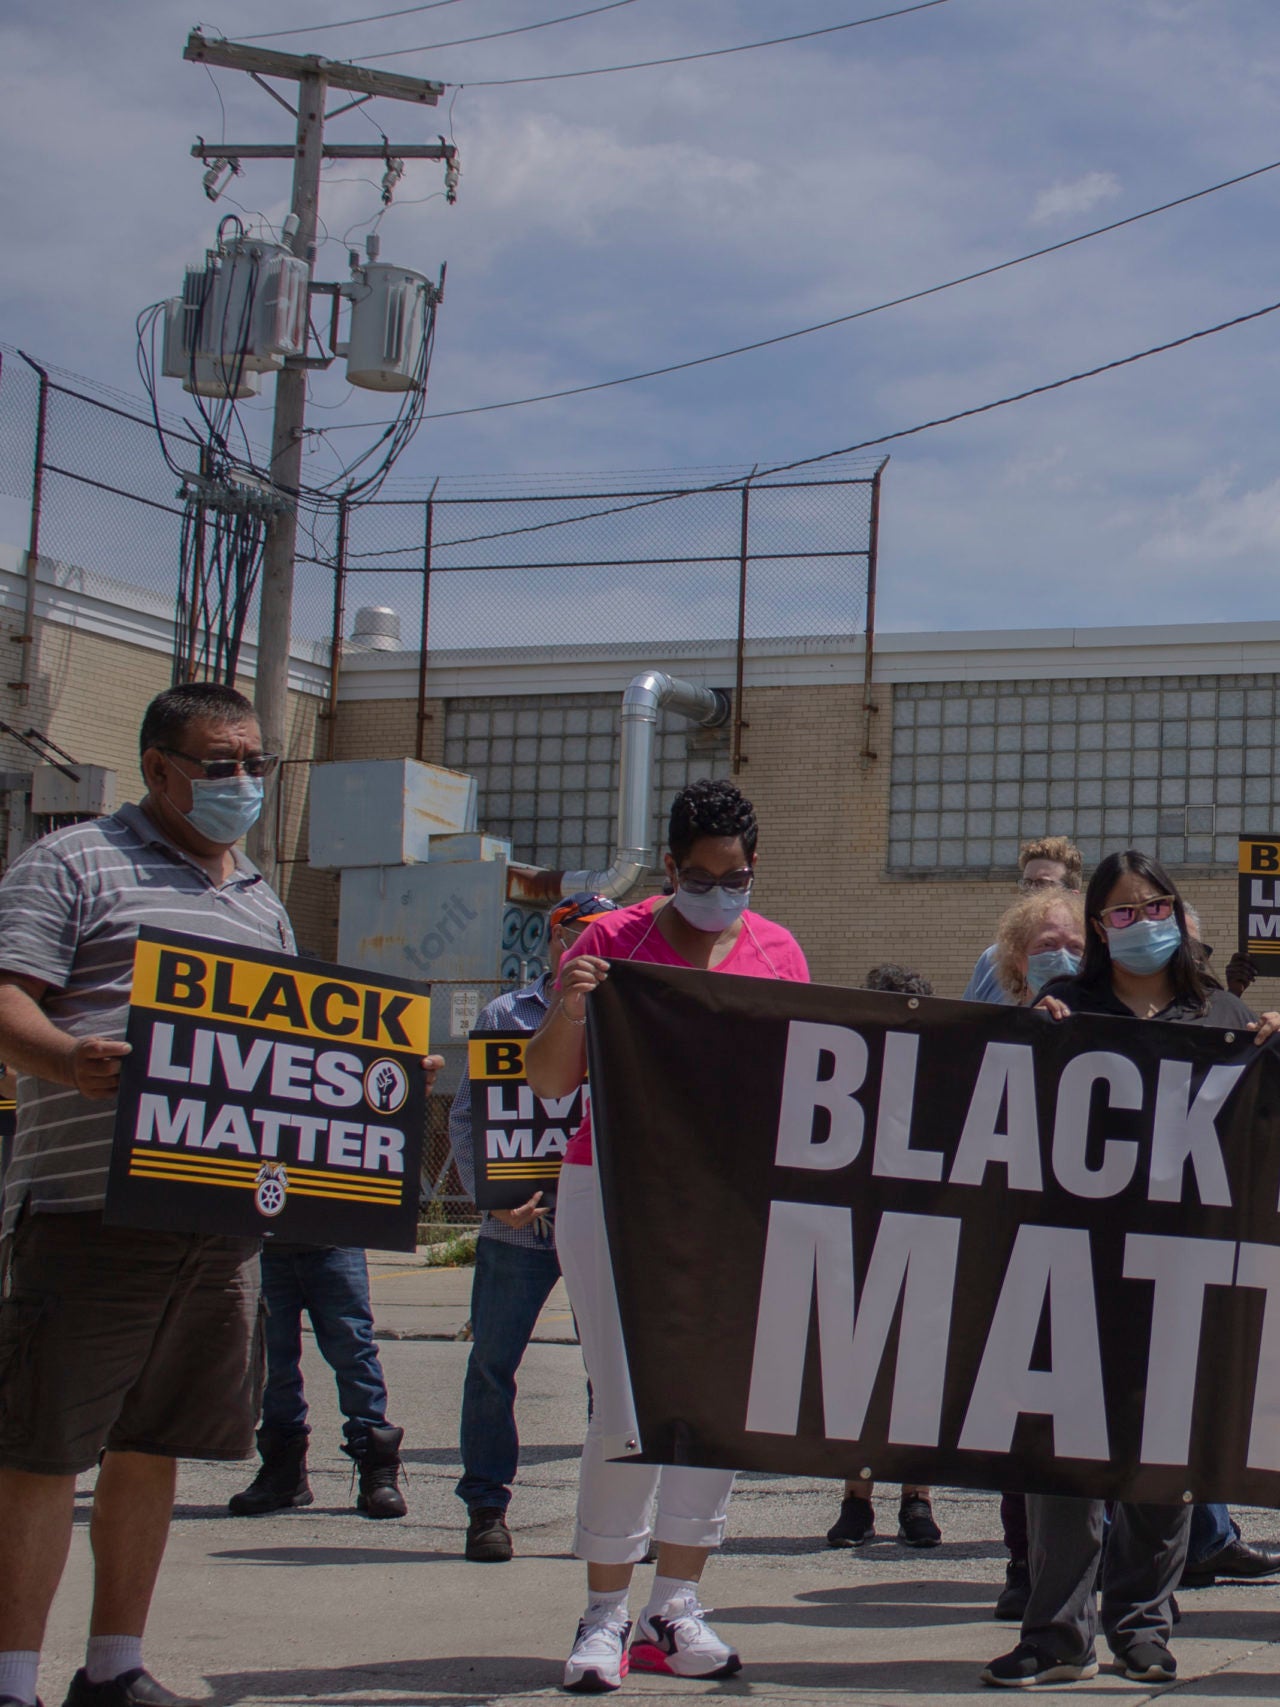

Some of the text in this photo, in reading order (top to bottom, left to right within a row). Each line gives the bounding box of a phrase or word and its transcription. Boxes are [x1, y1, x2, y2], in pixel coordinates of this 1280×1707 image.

[403, 894, 479, 971] torit
[155, 949, 414, 1047] BLACK
[147, 1021, 364, 1108] LIVES
[487, 1084, 591, 1121] LIV
[134, 1092, 406, 1173] MATTER
[774, 1020, 1247, 1207] BLACK
